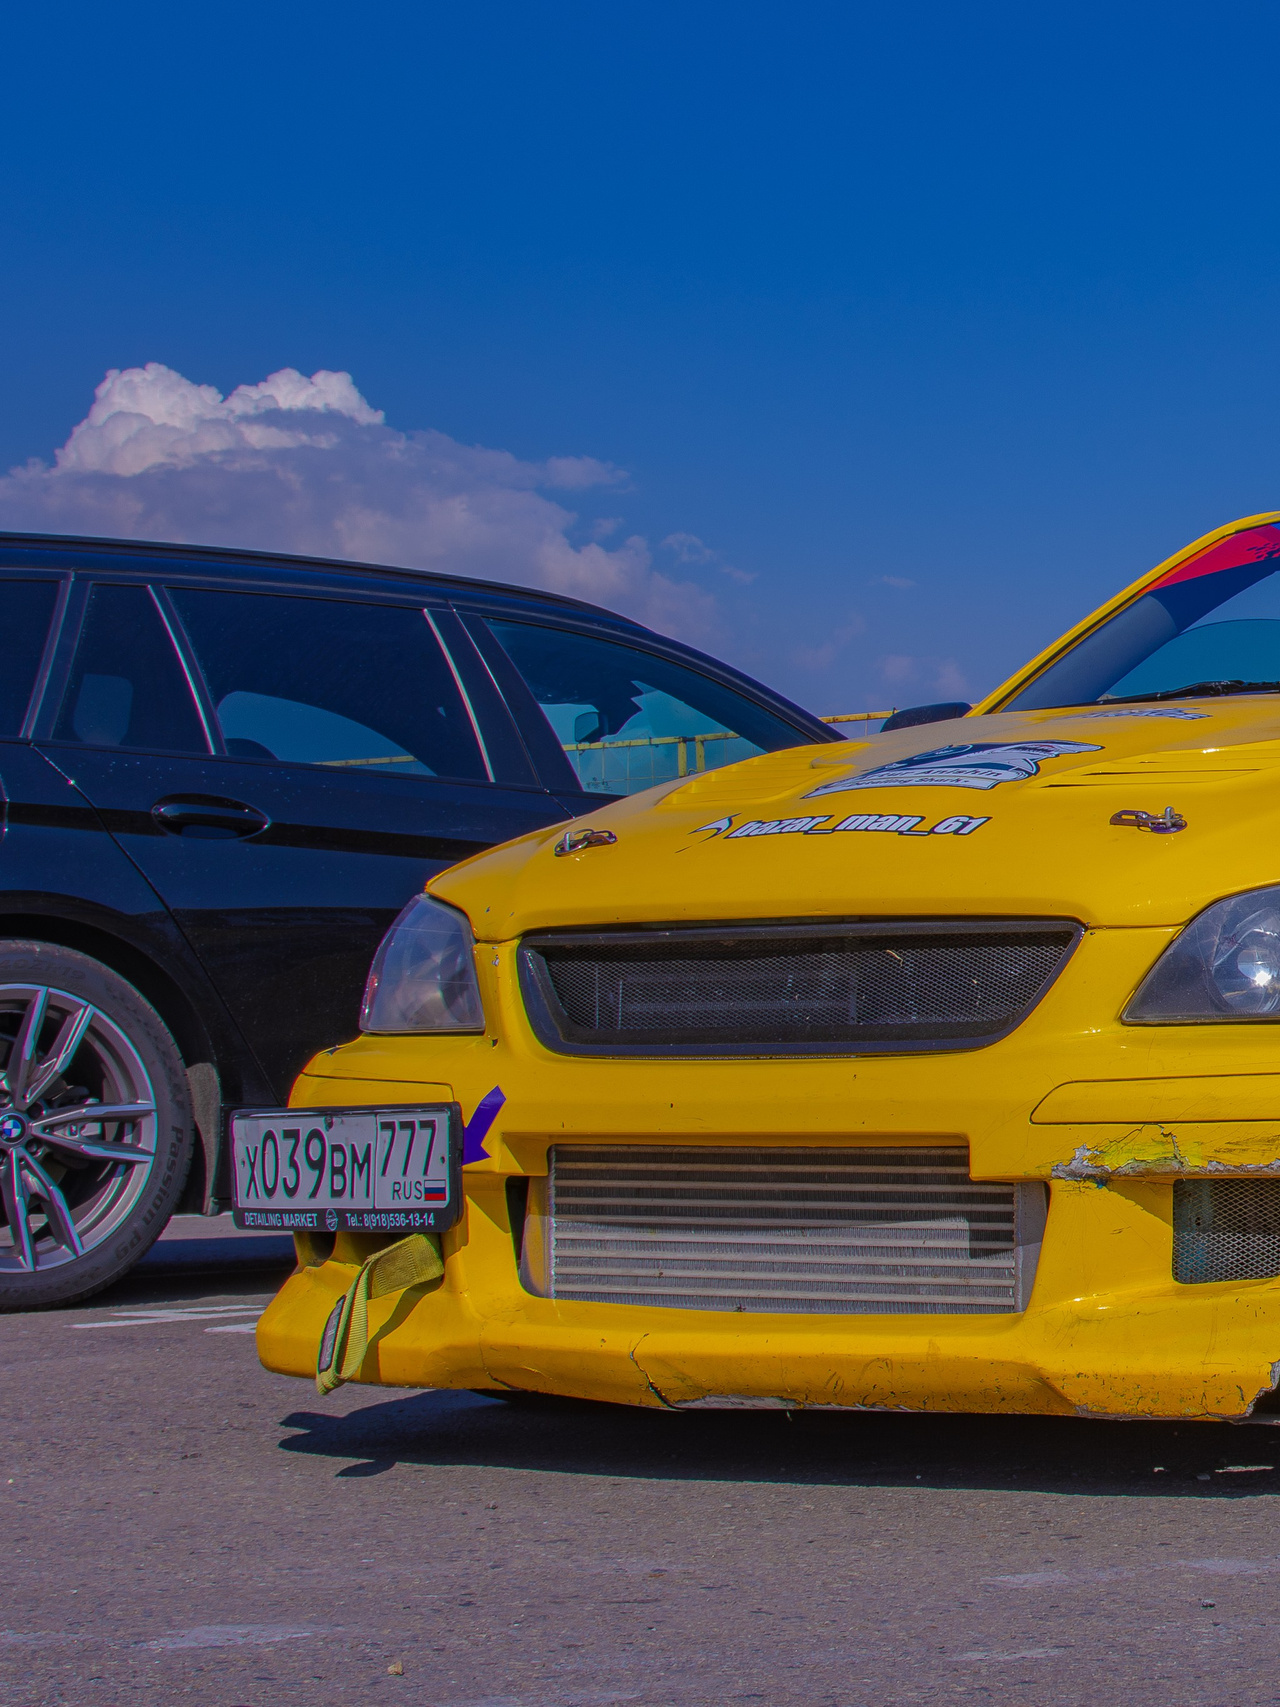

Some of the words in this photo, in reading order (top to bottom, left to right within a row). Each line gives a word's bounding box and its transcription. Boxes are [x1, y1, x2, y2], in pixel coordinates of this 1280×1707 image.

[726, 815, 989, 838] bazar_man_61
[379, 1118, 437, 1178] 777
[392, 1180, 424, 1201] RUS
[244, 1211, 282, 1226] DETAILING
[282, 1212, 318, 1227] MARKET
[363, 1212, 436, 1230] 8(918)536-13-14
